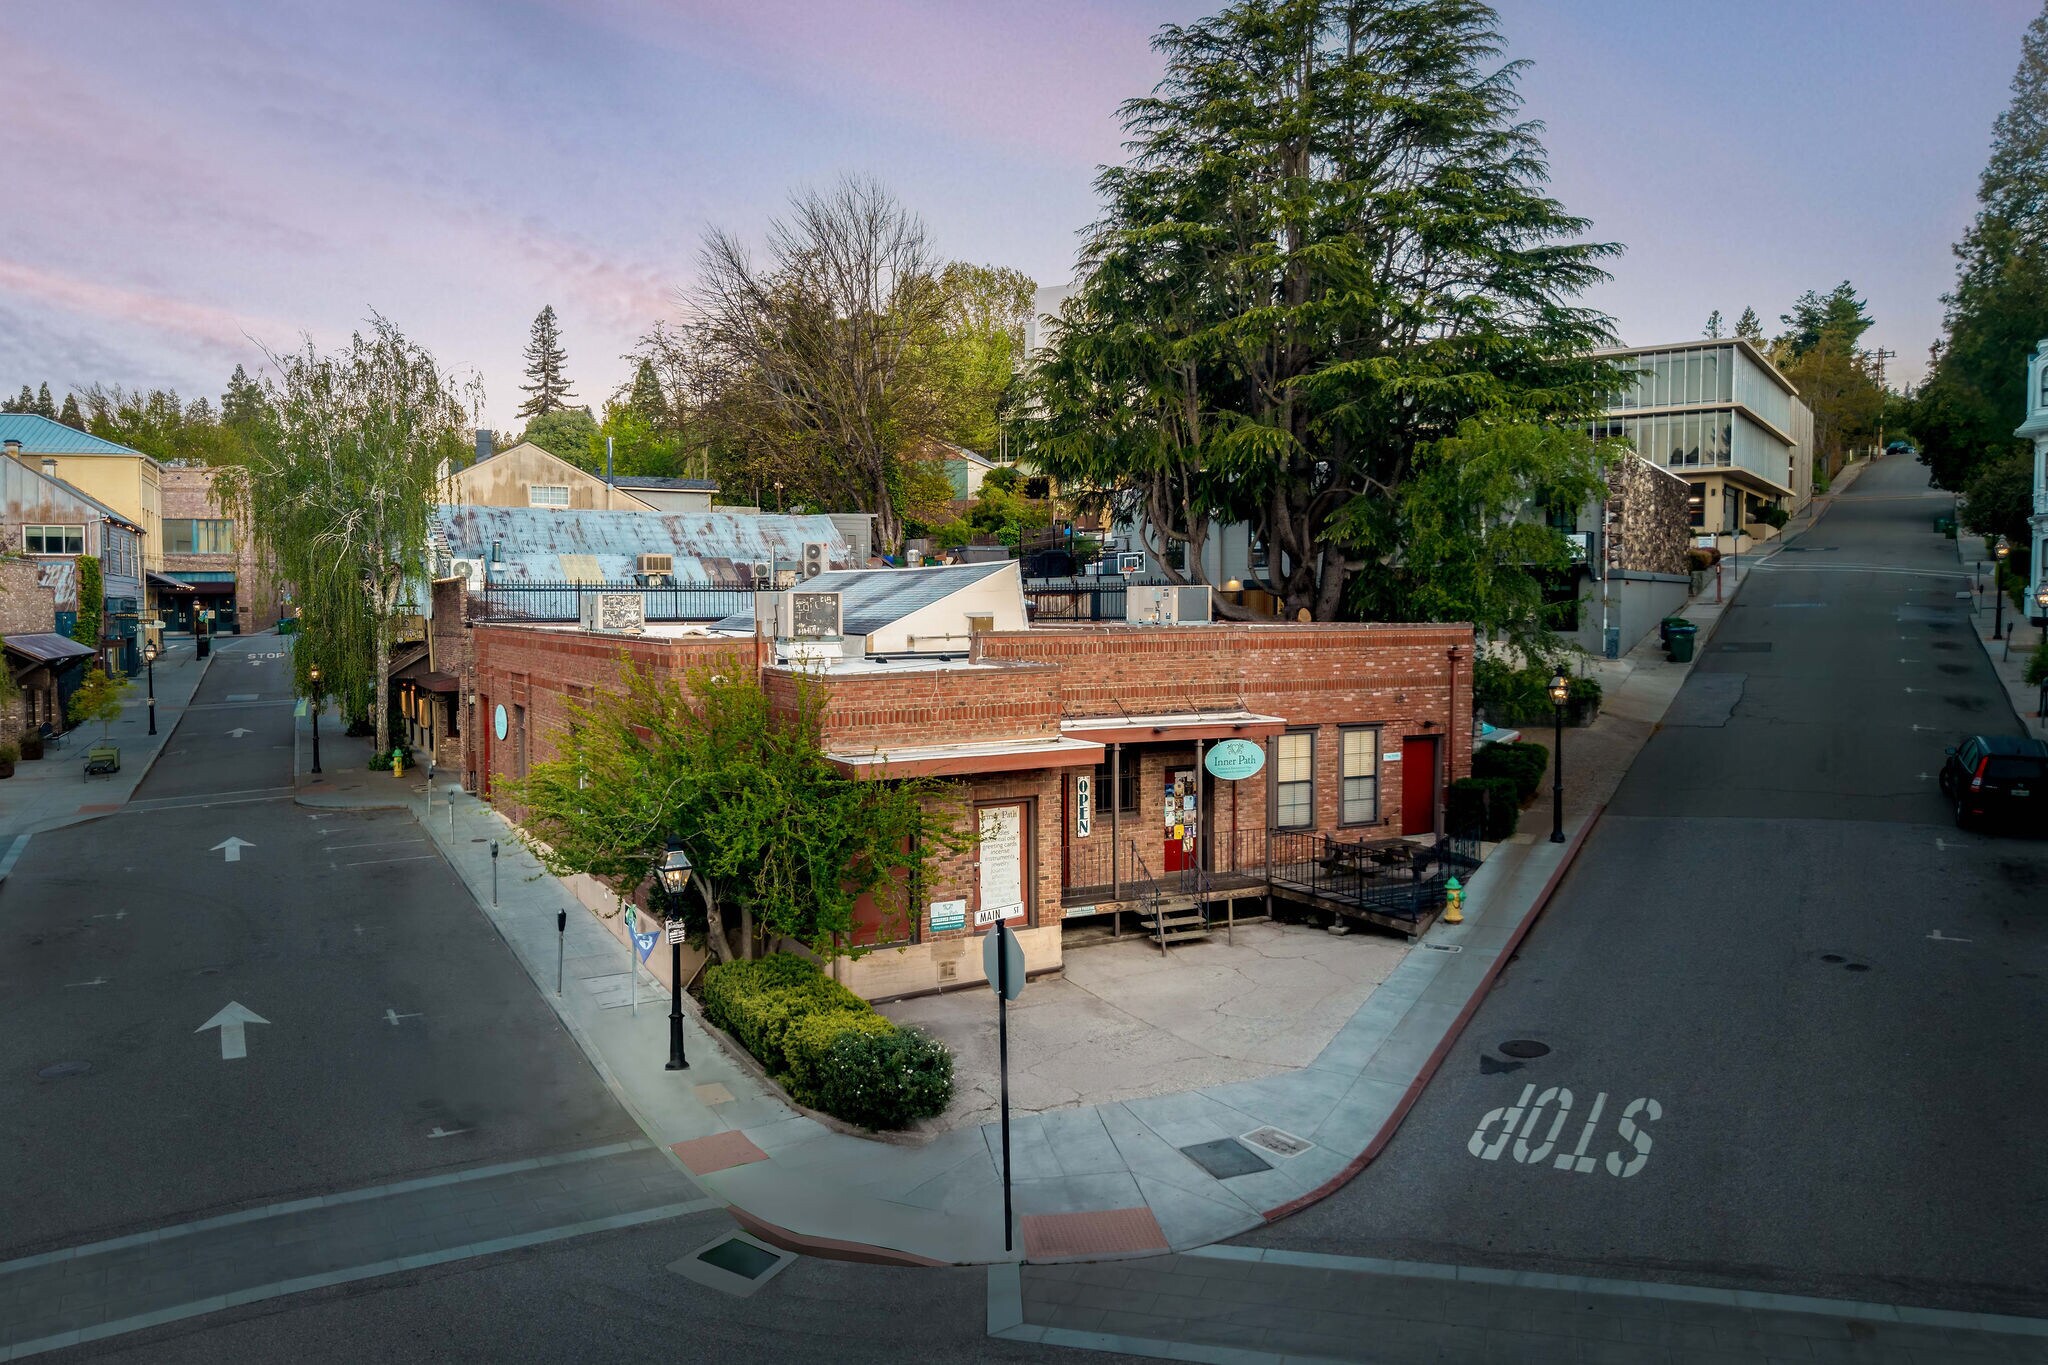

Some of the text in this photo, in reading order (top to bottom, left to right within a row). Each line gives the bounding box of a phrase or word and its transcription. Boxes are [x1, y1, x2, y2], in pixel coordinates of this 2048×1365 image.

[247, 652, 285, 660] STOP
[1214, 755, 1256, 766] Inner Path
[1079, 780, 1088, 834] OPEN
[1002, 810, 1018, 819] Path
[983, 843, 1003, 851] greeting
[980, 906, 1019, 922] MAIN ST
[1468, 1083, 1663, 1178] STOP
